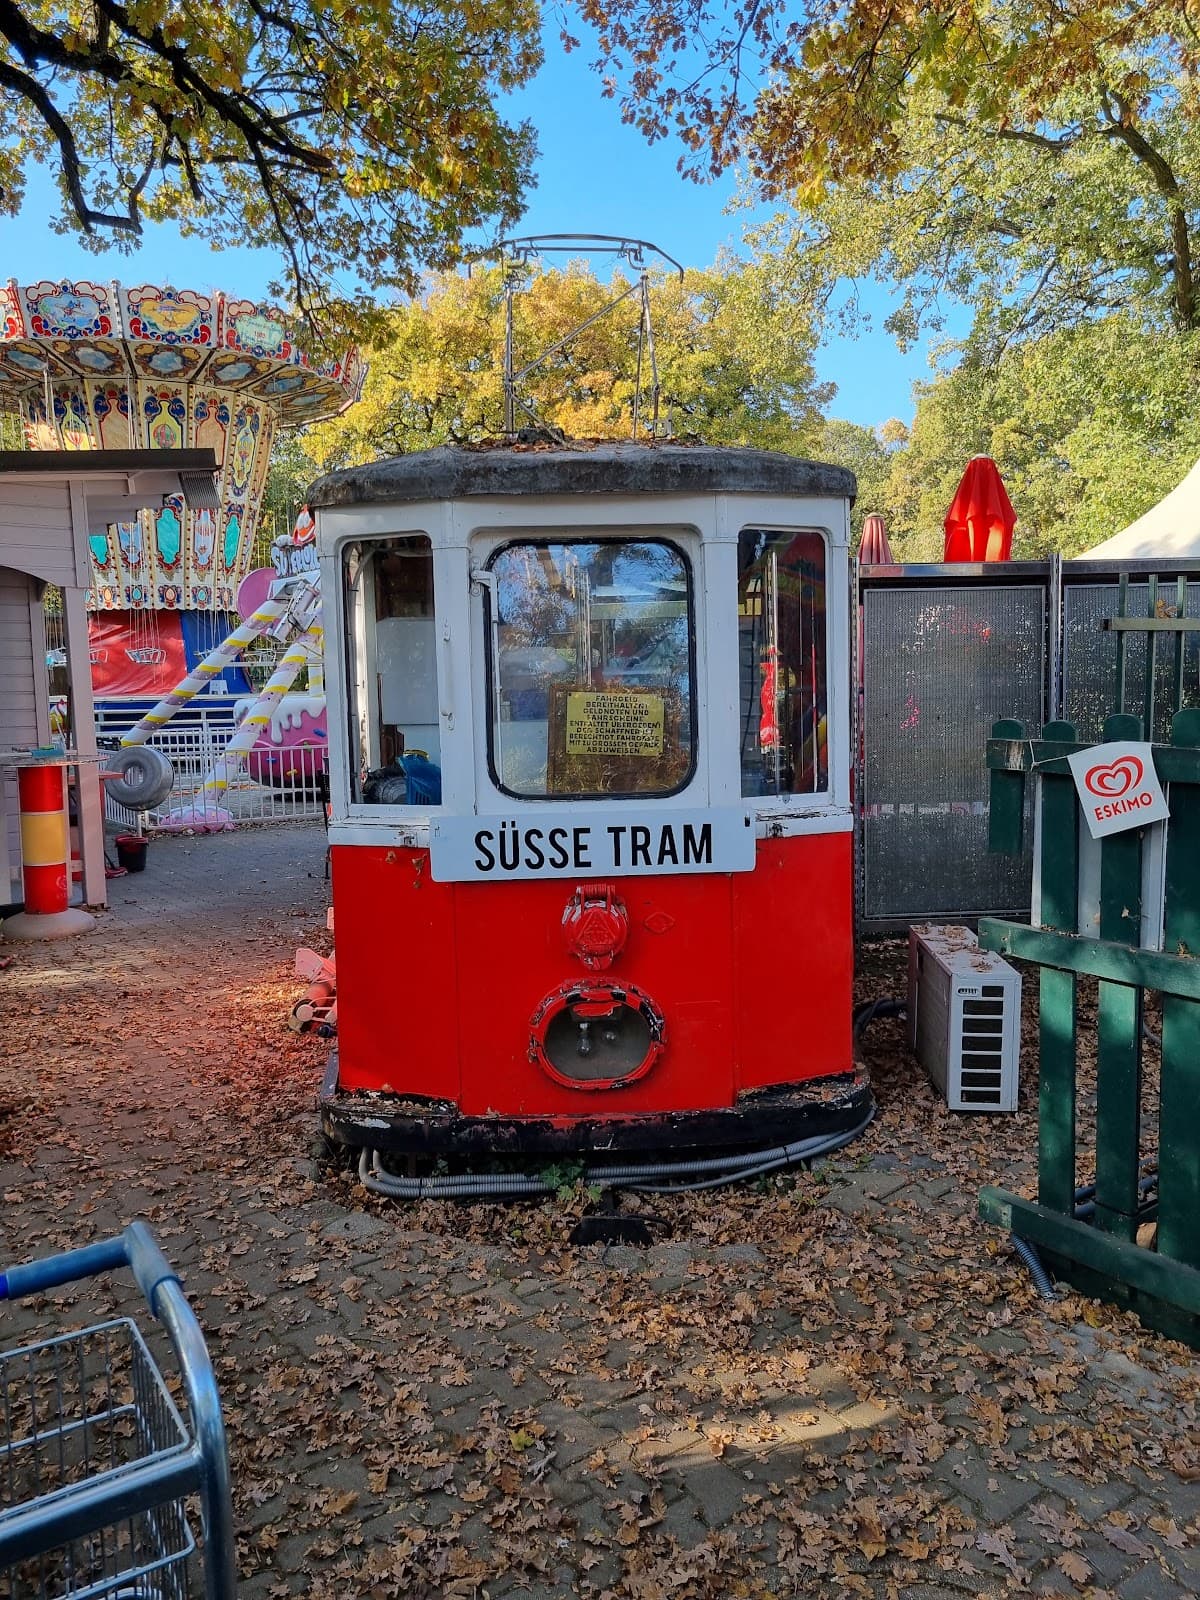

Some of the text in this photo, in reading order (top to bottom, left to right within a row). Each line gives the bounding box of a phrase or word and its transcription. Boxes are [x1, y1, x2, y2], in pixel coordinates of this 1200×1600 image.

[587, 714, 644, 722] FAHRSCHEINE
[569, 720, 609, 728] ENTFALTET
[595, 727, 641, 735] SCHAFFNER
[569, 733, 614, 741] BERECHTIGT
[592, 740, 627, 748] GROSSEM
[587, 746, 640, 754] ABZUWEISEN
[1094, 792, 1152, 821] ESKIMO
[475, 821, 713, 871] SÜSSE TRAM
